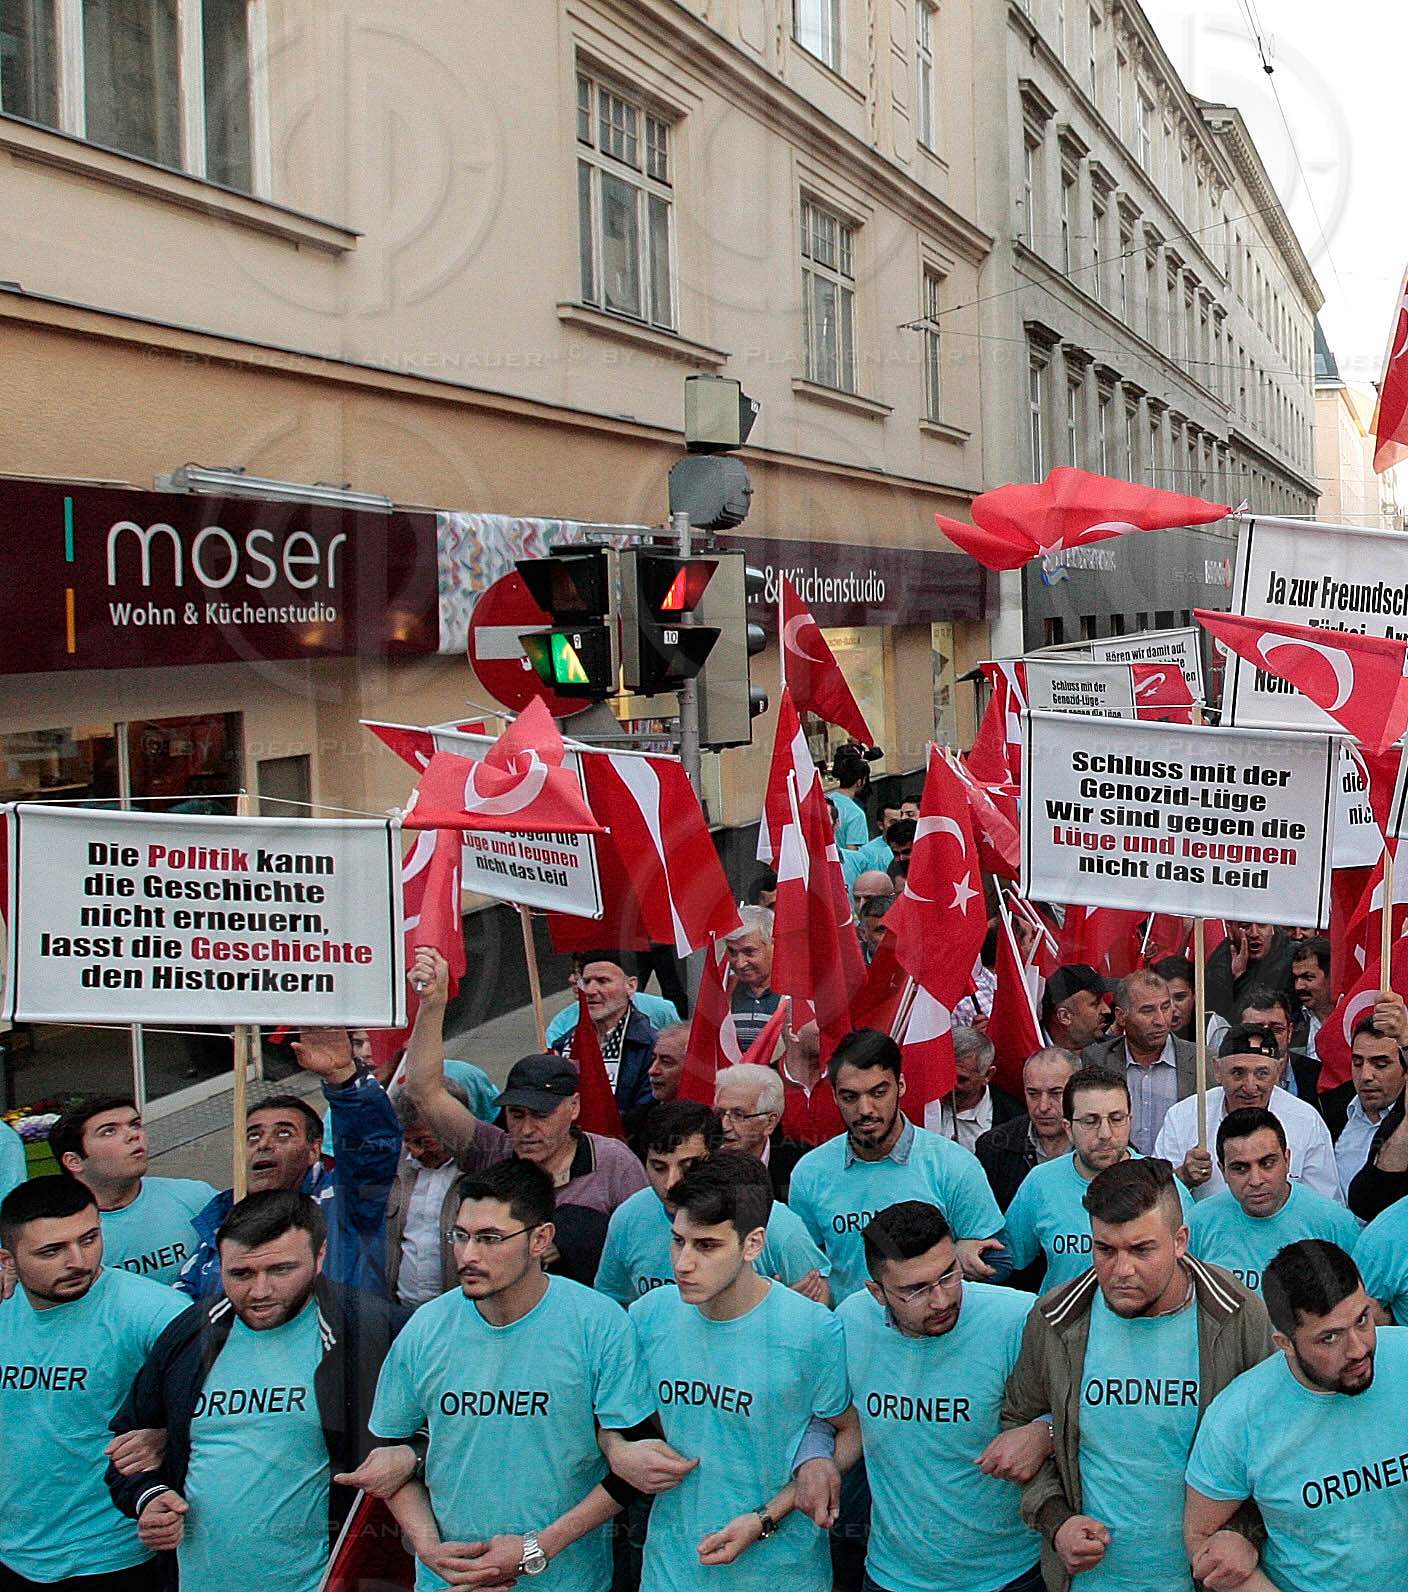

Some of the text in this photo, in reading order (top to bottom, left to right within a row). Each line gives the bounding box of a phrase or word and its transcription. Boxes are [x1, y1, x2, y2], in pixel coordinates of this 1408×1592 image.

[107, 520, 347, 589] moser
[1266, 570, 1286, 605] Ja
[1289, 577, 1319, 608] zur
[109, 602, 337, 626] Wohn & Küchenstudio
[666, 631, 677, 644] 10
[1131, 647, 1145, 659] wir
[1146, 643, 1169, 658] damit
[1051, 679, 1106, 693] Schluss mit der
[1052, 693, 1100, 706] Genozid-Lüge
[1072, 751, 1291, 788] Schluss mit der
[1080, 777, 1267, 813] Genozid-Lüge
[1045, 800, 1306, 840] Wir sind gegen die
[88, 841, 334, 875] Die Politik kann
[491, 839, 517, 857] und
[519, 842, 579, 868] leugnen
[1053, 825, 1297, 866] Lüge und leugnen
[476, 854, 568, 887] nicht das Leid
[1079, 855, 1268, 889] nicht das Leid
[84, 873, 325, 904] die Geschichte
[81, 904, 329, 936] nicht erneuern,
[41, 933, 373, 965] lasst die Geschichte
[81, 964, 334, 993] den Historikern
[111, 1242, 188, 1275] DNER
[0, 1366, 88, 1392] RDNER
[1085, 1378, 1198, 1408] ORDNER
[440, 1390, 550, 1417] ORDNER
[658, 1378, 753, 1418] ORDNER
[867, 1391, 971, 1423] ORDNER
